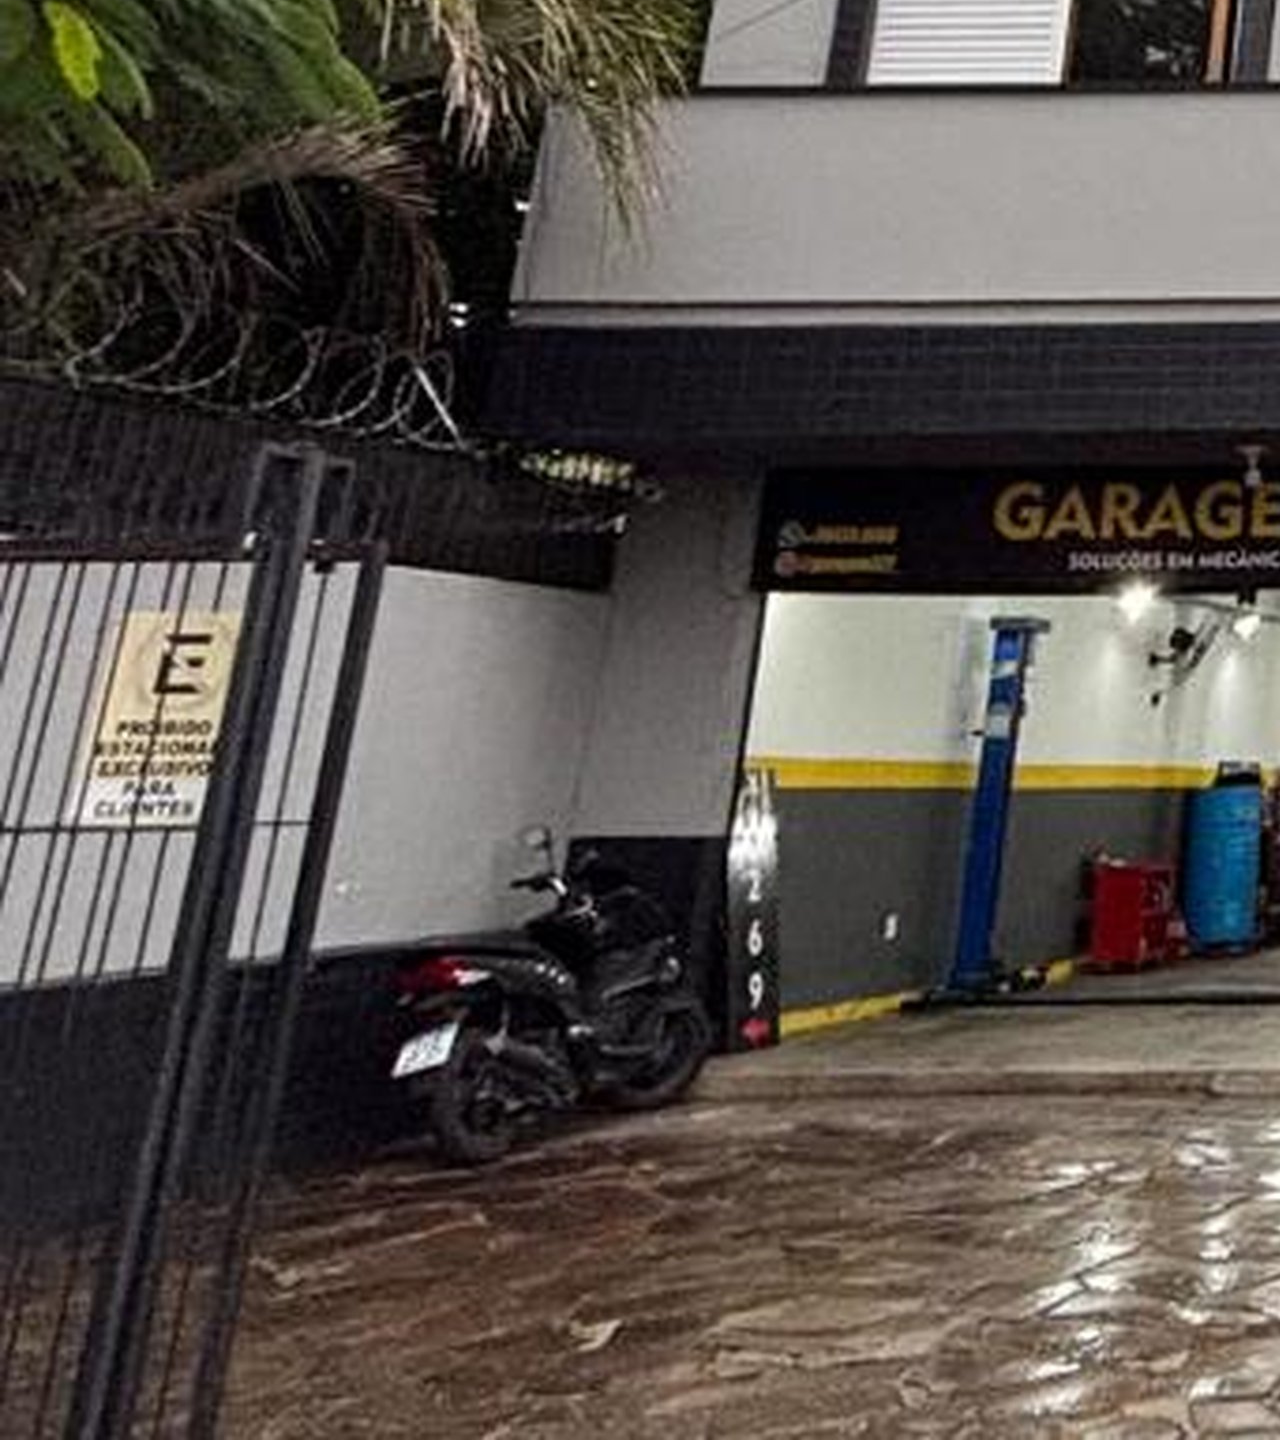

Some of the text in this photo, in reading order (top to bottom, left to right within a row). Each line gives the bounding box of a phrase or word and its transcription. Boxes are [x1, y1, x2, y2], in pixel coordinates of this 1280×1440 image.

[1068, 549, 1162, 572] SOLUÇÕES
[1166, 552, 1195, 569] EM
[152, 633, 214, 694] E
